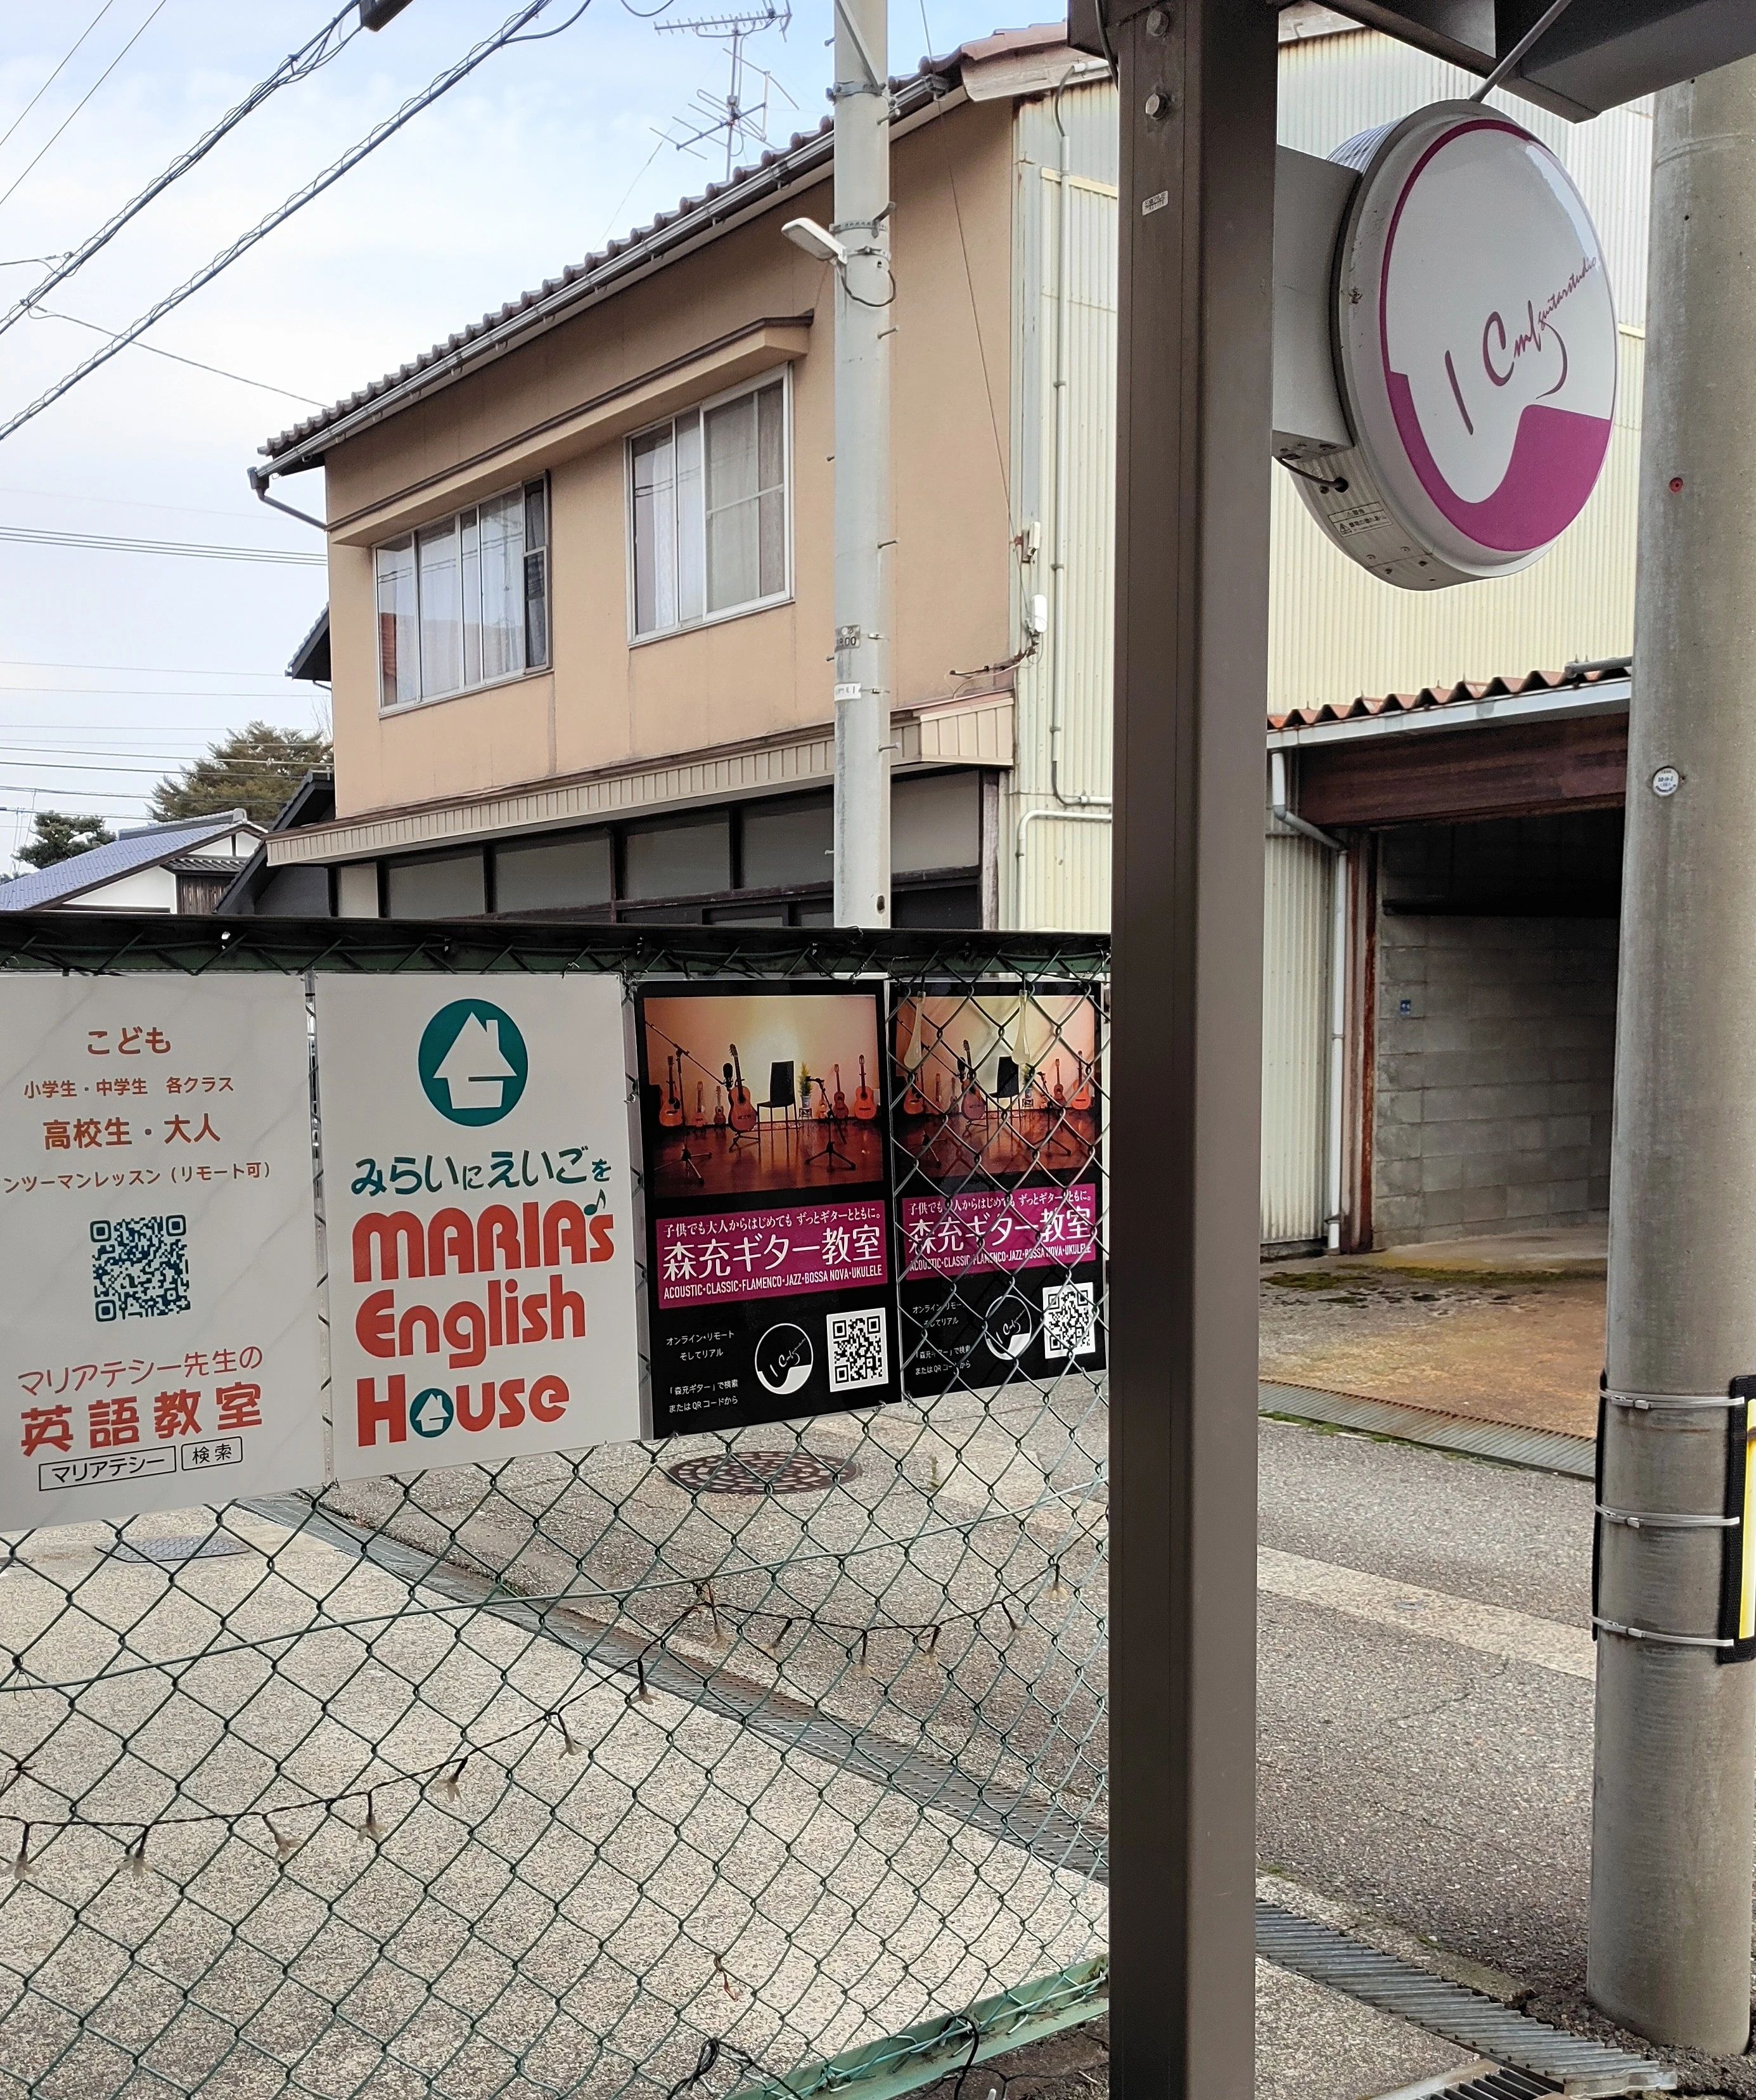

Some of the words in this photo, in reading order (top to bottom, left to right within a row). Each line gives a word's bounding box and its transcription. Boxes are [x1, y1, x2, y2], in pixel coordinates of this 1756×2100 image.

[87, 1026, 171, 1055] こども
[23, 1079, 148, 1098] 小学生・中学生
[166, 1076, 234, 1094] 各クラス
[43, 1113, 221, 1150] 高校生・大人
[0, 1162, 271, 1194] ンツーマンレッスン（リモート可）
[350, 1145, 612, 1197] みらいにえいごを
[1018, 1190, 1091, 1206] ずっとギターともに。
[663, 1214, 791, 1238] 子供でも大人からはじめても
[797, 1207, 880, 1226] ずっとギターとともに。
[663, 1224, 881, 1282] 森充ギター教室
[355, 1274, 586, 1369] English
[18, 1346, 263, 1396] マリアテシー先生の
[680, 1348, 724, 1361] そしてリアル
[21, 1382, 262, 1457] 英語教室
[52, 1456, 165, 1483] マリアテシー
[193, 1443, 232, 1465] 検索
